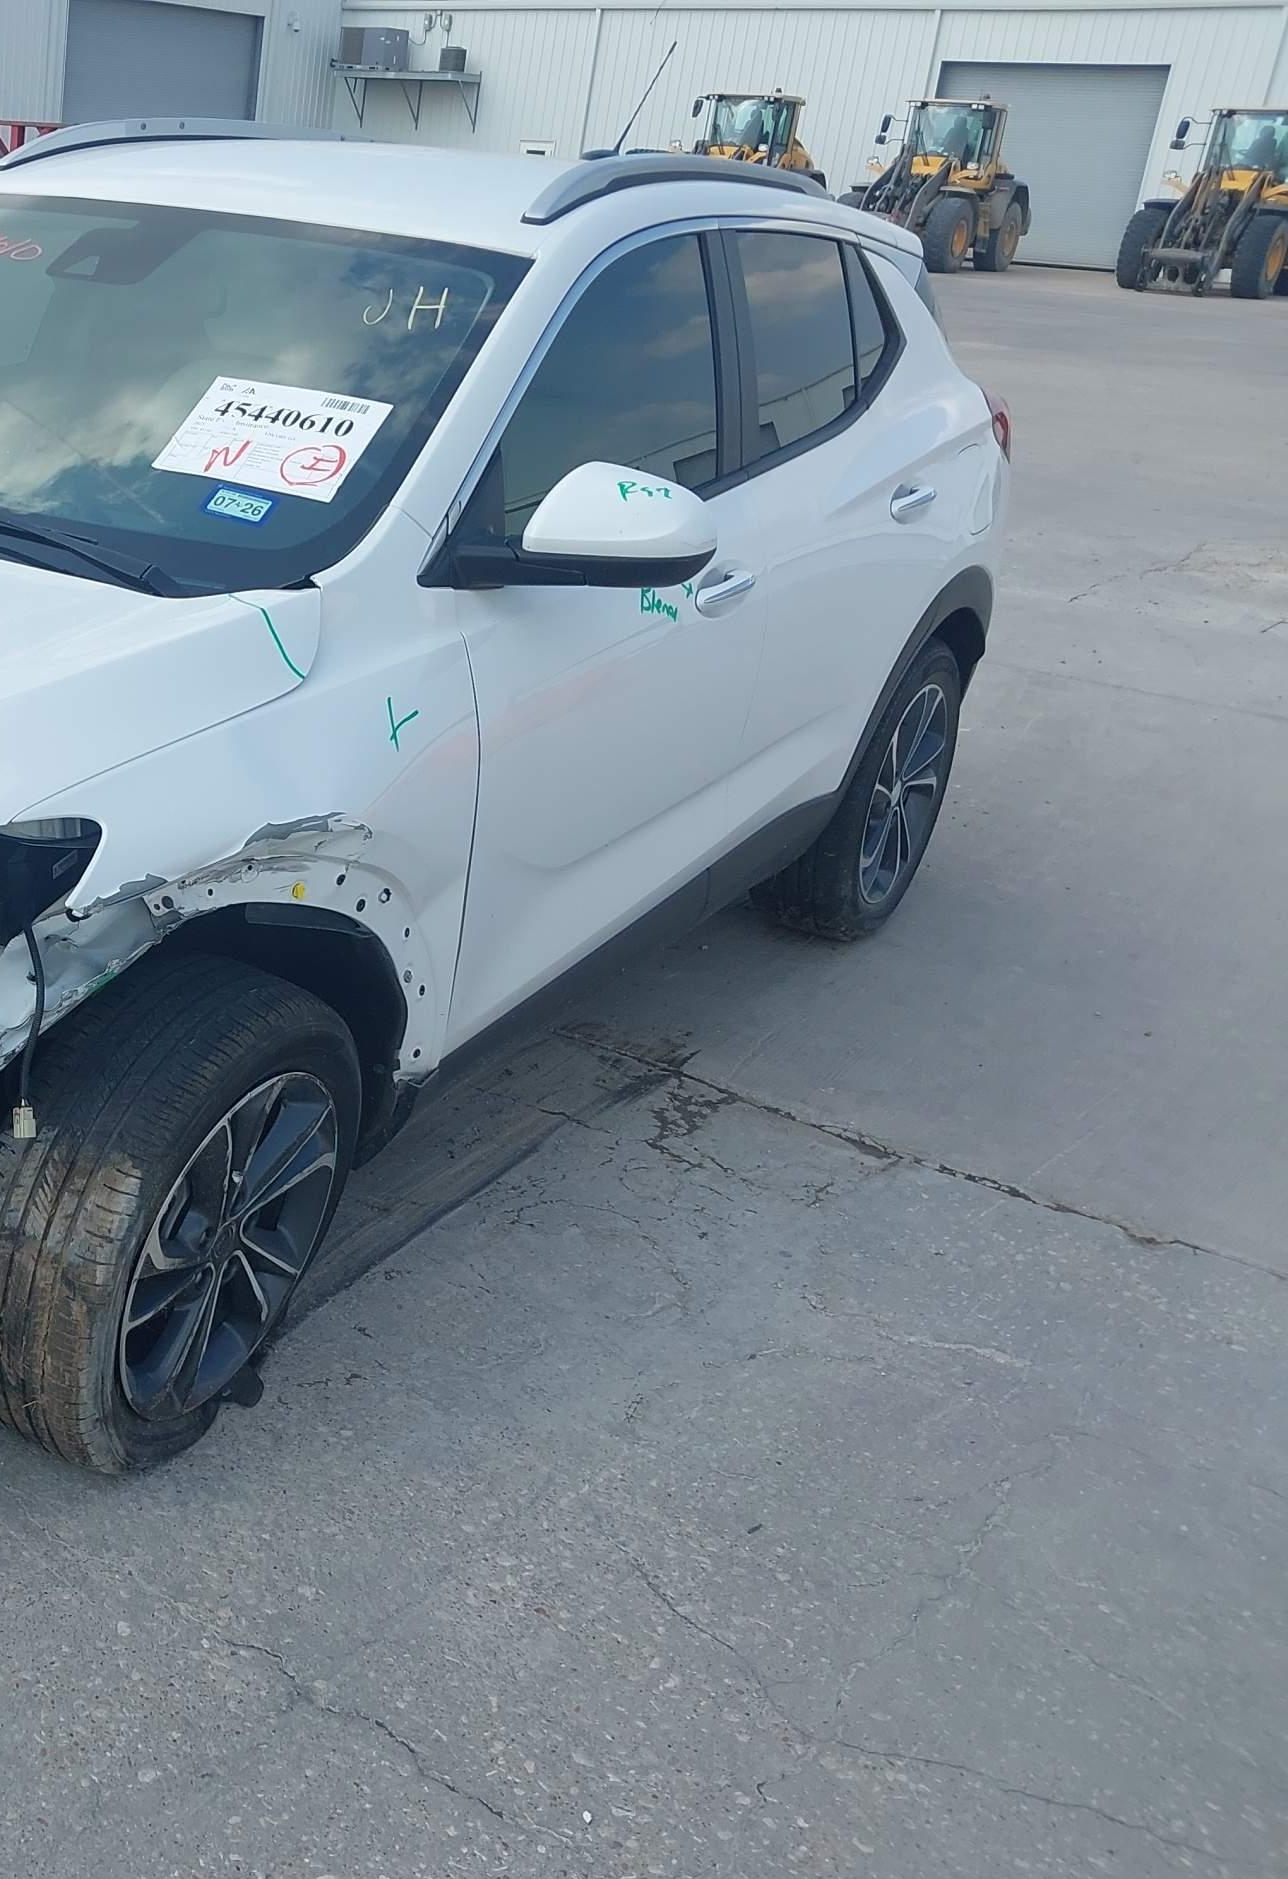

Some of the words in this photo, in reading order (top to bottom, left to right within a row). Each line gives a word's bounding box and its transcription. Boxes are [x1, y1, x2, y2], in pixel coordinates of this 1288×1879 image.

[214, 400, 355, 437] 45440610
[213, 495, 238, 509] 07
[239, 502, 265, 517] 26
